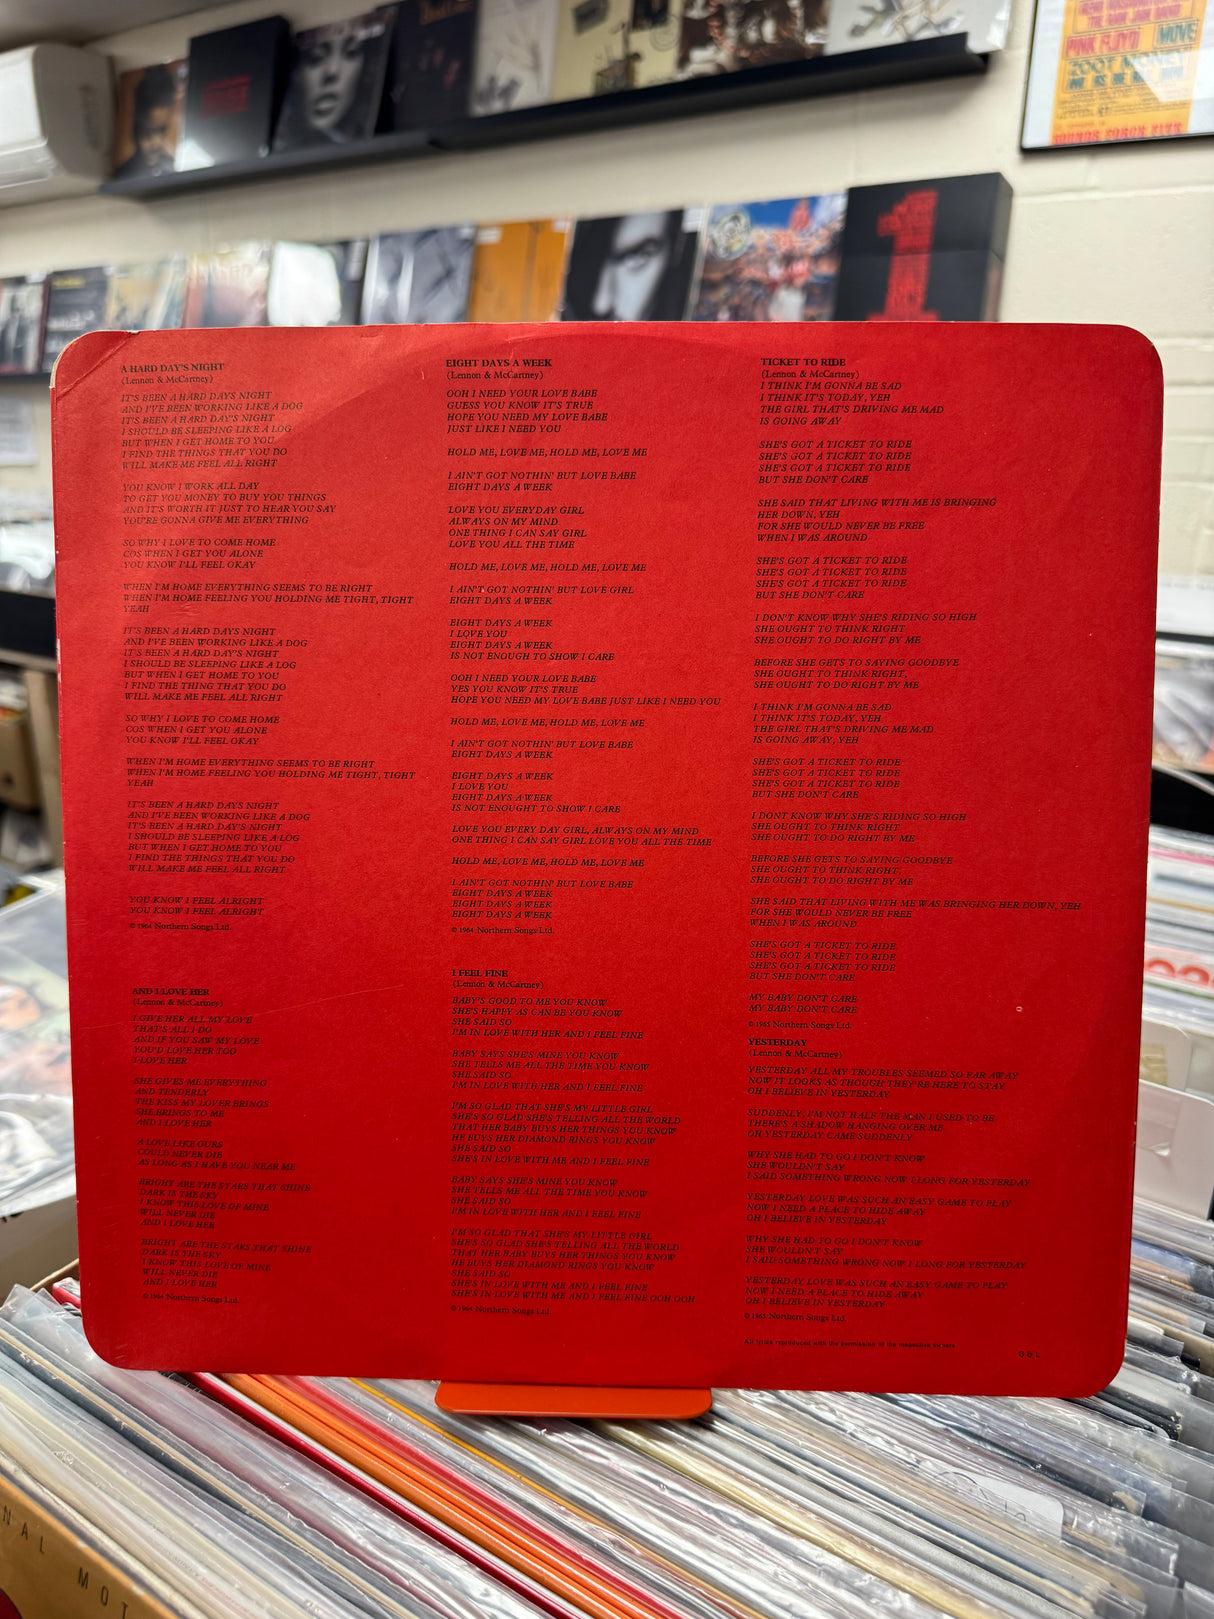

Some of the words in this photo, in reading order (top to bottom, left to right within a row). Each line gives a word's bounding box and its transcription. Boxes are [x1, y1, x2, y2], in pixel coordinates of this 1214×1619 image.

[1065, 37, 1096, 58] PINK
[445, 359, 480, 368] EIGHT
[481, 359, 510, 367] DAYS
[512, 359, 520, 367] A
[521, 358, 552, 367] WEEK
[760, 357, 801, 366] TICKET
[802, 358, 818, 366] TO
[820, 358, 846, 367] RIDE
[120, 365, 127, 373] A
[129, 364, 158, 373] HARD
[159, 363, 189, 372] DAY'S
[190, 362, 225, 371] NIGHT
[120, 376, 154, 385] (Lennon
[156, 375, 164, 384] &
[165, 374, 213, 384] McCartney)
[446, 371, 481, 380] (Lennon
[483, 370, 491, 379] &
[493, 370, 544, 380] McCartney)
[761, 369, 797, 379] (Lennon
[798, 369, 807, 378] &
[808, 369, 860, 380] McCartney)
[445, 389, 469, 398] OOH
[471, 389, 476, 398] I
[478, 389, 507, 398] NEED
[509, 389, 539, 398] YOUR
[540, 389, 569, 398] LOVE
[570, 389, 598, 398] BABE
[760, 404, 782, 414] THE
[783, 405, 810, 414] GIRL
[812, 404, 850, 414] THAT'S
[851, 404, 899, 414] DRIVING
[900, 405, 918, 414] ME
[918, 405, 944, 414] MAD
[446, 447, 477, 456] HOLD
[478, 448, 497, 458] ME,
[499, 447, 527, 457] LOVE
[528, 448, 548, 458] ME,
[548, 448, 579, 457] HOLD
[581, 448, 600, 458] ME,
[601, 447, 630, 457] LOVE
[631, 447, 648, 457] ME
[448, 528, 470, 537] ONE
[472, 528, 506, 537] THING
[508, 528, 513, 537] I
[514, 528, 537, 537] CAN
[538, 528, 560, 538] SAY
[561, 529, 587, 538] GIRL
[123, 582, 152, 591] WHEN
[154, 582, 170, 591] I'M
[171, 583, 203, 591] HOME
[204, 583, 271, 592] EVERYTHING
[272, 583, 306, 592] SEEMS
[308, 583, 323, 592] TO
[324, 584, 338, 592] BE
[339, 584, 373, 593] RIGHT
[753, 658, 794, 667] BEFORE
[794, 658, 817, 667] SHE
[817, 658, 846, 667] GETS
[847, 658, 863, 667] TO
[863, 658, 905, 667] SAYING
[907, 658, 960, 667] GOODBYE
[124, 692, 150, 701] WILL
[151, 692, 182, 701] MAKE
[183, 692, 199, 701] ME
[200, 692, 226, 701] FEEL
[227, 693, 248, 702] ALL
[249, 693, 283, 702] RIGHT
[451, 803, 462, 812] IS
[463, 803, 486, 812] NOT
[487, 804, 538, 812] ENOUGHT
[539, 804, 554, 813] TO
[555, 804, 586, 813] SHOW
[587, 804, 592, 813] I
[594, 805, 621, 813] CARE
[129, 895, 151, 904] YOU
[152, 895, 184, 904] KNOW
[184, 896, 190, 905] I
[191, 896, 216, 905] FEEL
[217, 896, 265, 905] ALRIGHT
[476, 926, 512, 934] Northern
[513, 926, 537, 936] Songs
[451, 969, 456, 977] I
[458, 969, 483, 977] FEEL
[484, 969, 508, 978] FINE
[452, 979, 485, 988] (Lennon
[487, 980, 495, 988] &
[496, 980, 544, 990] McCartney)
[131, 987, 153, 995] AND
[154, 987, 160, 995] I
[160, 987, 188, 996] LOVE
[189, 988, 210, 996] HER
[451, 996, 486, 1005] BABY'S
[487, 996, 517, 1005] GOOD
[519, 997, 533, 1006] TO
[534, 997, 551, 1006] ME
[552, 997, 574, 1006] YOU
[575, 998, 608, 1007] KNOW
[132, 1014, 137, 1022] I
[138, 1014, 163, 1023] GIVE
[164, 1014, 185, 1023] HER
[186, 1015, 206, 1024] ALL
[207, 1015, 224, 1024] MY
[225, 1015, 253, 1024] LOVE
[772, 1020, 809, 1029] Northern
[809, 1020, 834, 1031] Songs
[748, 1037, 808, 1047] YESTERDAY
[748, 1065, 808, 1075] YESTERDAY
[809, 1066, 830, 1075] ALL
[831, 1067, 848, 1076] MY
[850, 1067, 904, 1077] TROUBLES
[905, 1069, 948, 1078] SEEMED
[948, 1070, 963, 1079] SO
[965, 1070, 986, 1079] FAR
[987, 1071, 1019, 1080] AWAY
[450, 1112, 479, 1121] SHE'S
[480, 1112, 494, 1121] SO
[495, 1112, 524, 1121] GLAD
[525, 1113, 553, 1122] SHE'S
[555, 1114, 599, 1123] TELLING
[600, 1115, 620, 1124] ALL
[622, 1115, 643, 1124] THE
[644, 1116, 681, 1125] WORLD
